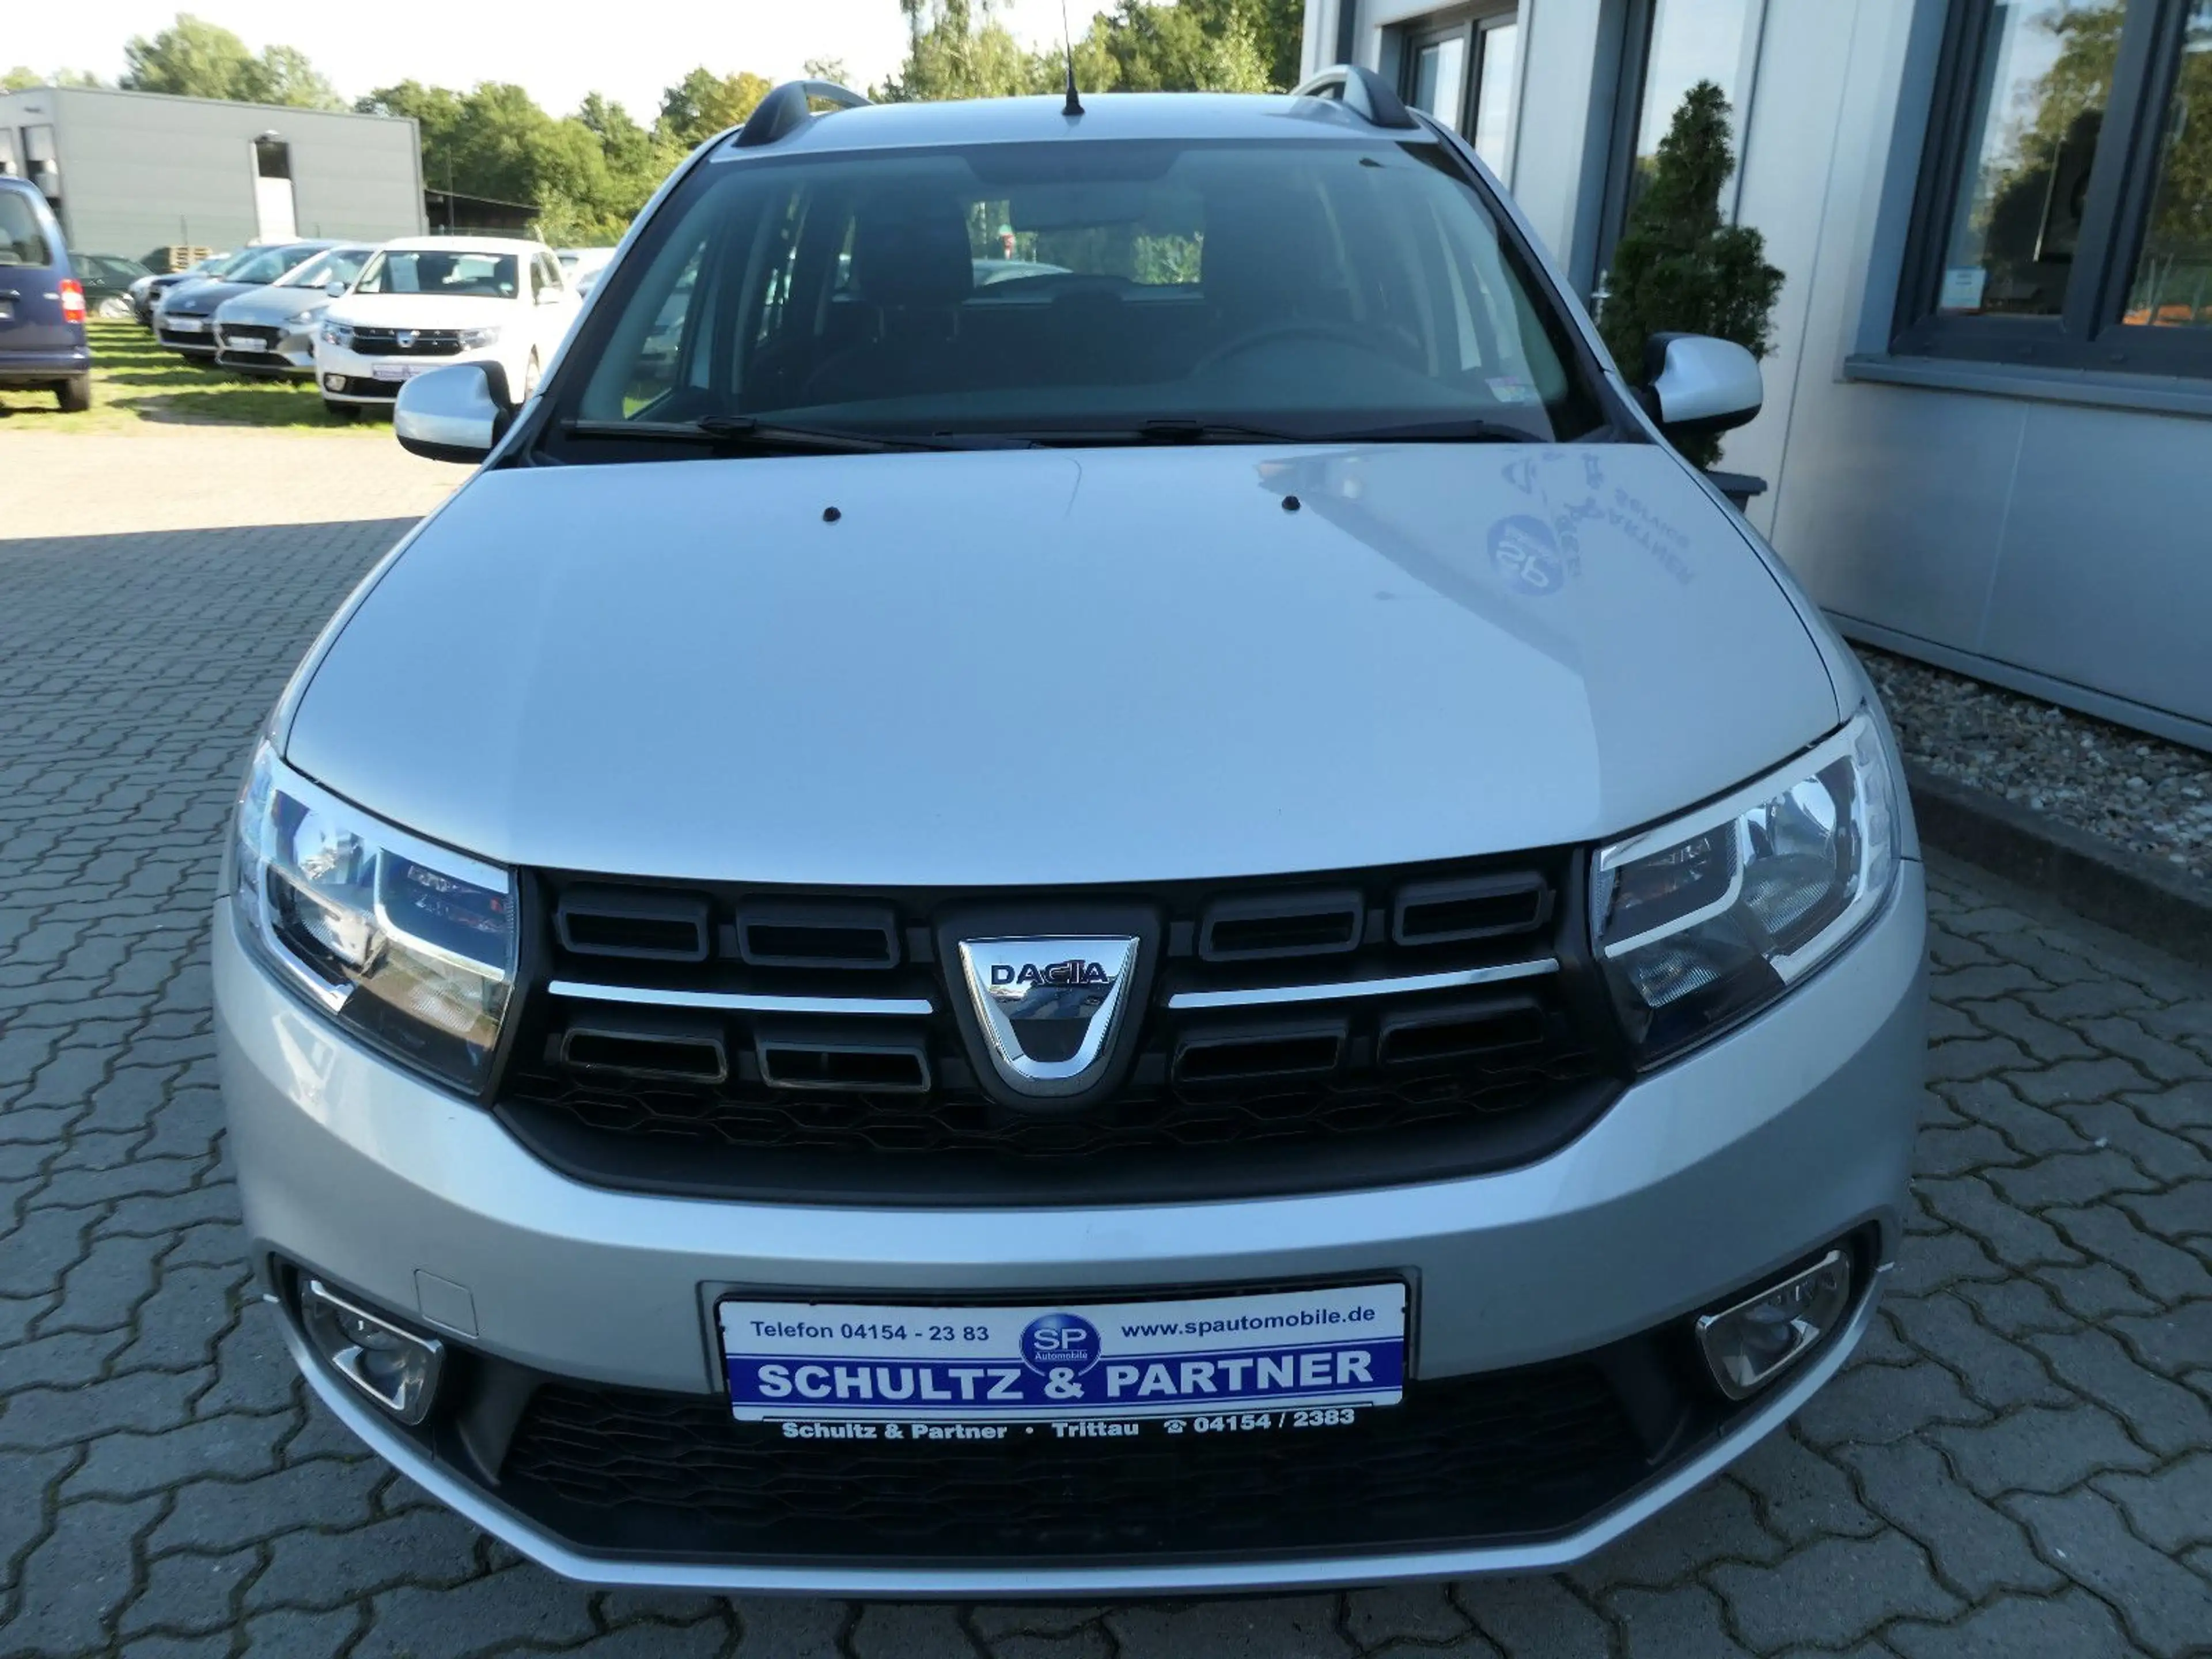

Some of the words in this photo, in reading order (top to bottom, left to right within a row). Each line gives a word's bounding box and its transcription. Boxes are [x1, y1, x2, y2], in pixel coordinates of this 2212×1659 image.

[990, 962, 1109, 985] DACIA
[750, 1321, 834, 1339] Telefon
[841, 1324, 907, 1341] 04154
[929, 1325, 955, 1341] 23
[963, 1325, 990, 1341] 83
[1122, 1306, 1376, 1337] www.spautomobile.de
[1033, 1328, 1088, 1350] SP
[757, 1364, 1024, 1400] SCHULTZ
[1044, 1366, 1085, 1399] &
[1107, 1350, 1373, 1397] PARTNER
[782, 1421, 877, 1439] Schultz
[885, 1423, 904, 1439] &
[912, 1423, 1008, 1440] Partner
[1052, 1421, 1139, 1437] Trittau
[1194, 1412, 1272, 1433] 04154
[1278, 1412, 1286, 1429] /
[1294, 1408, 1355, 1427] 2383
